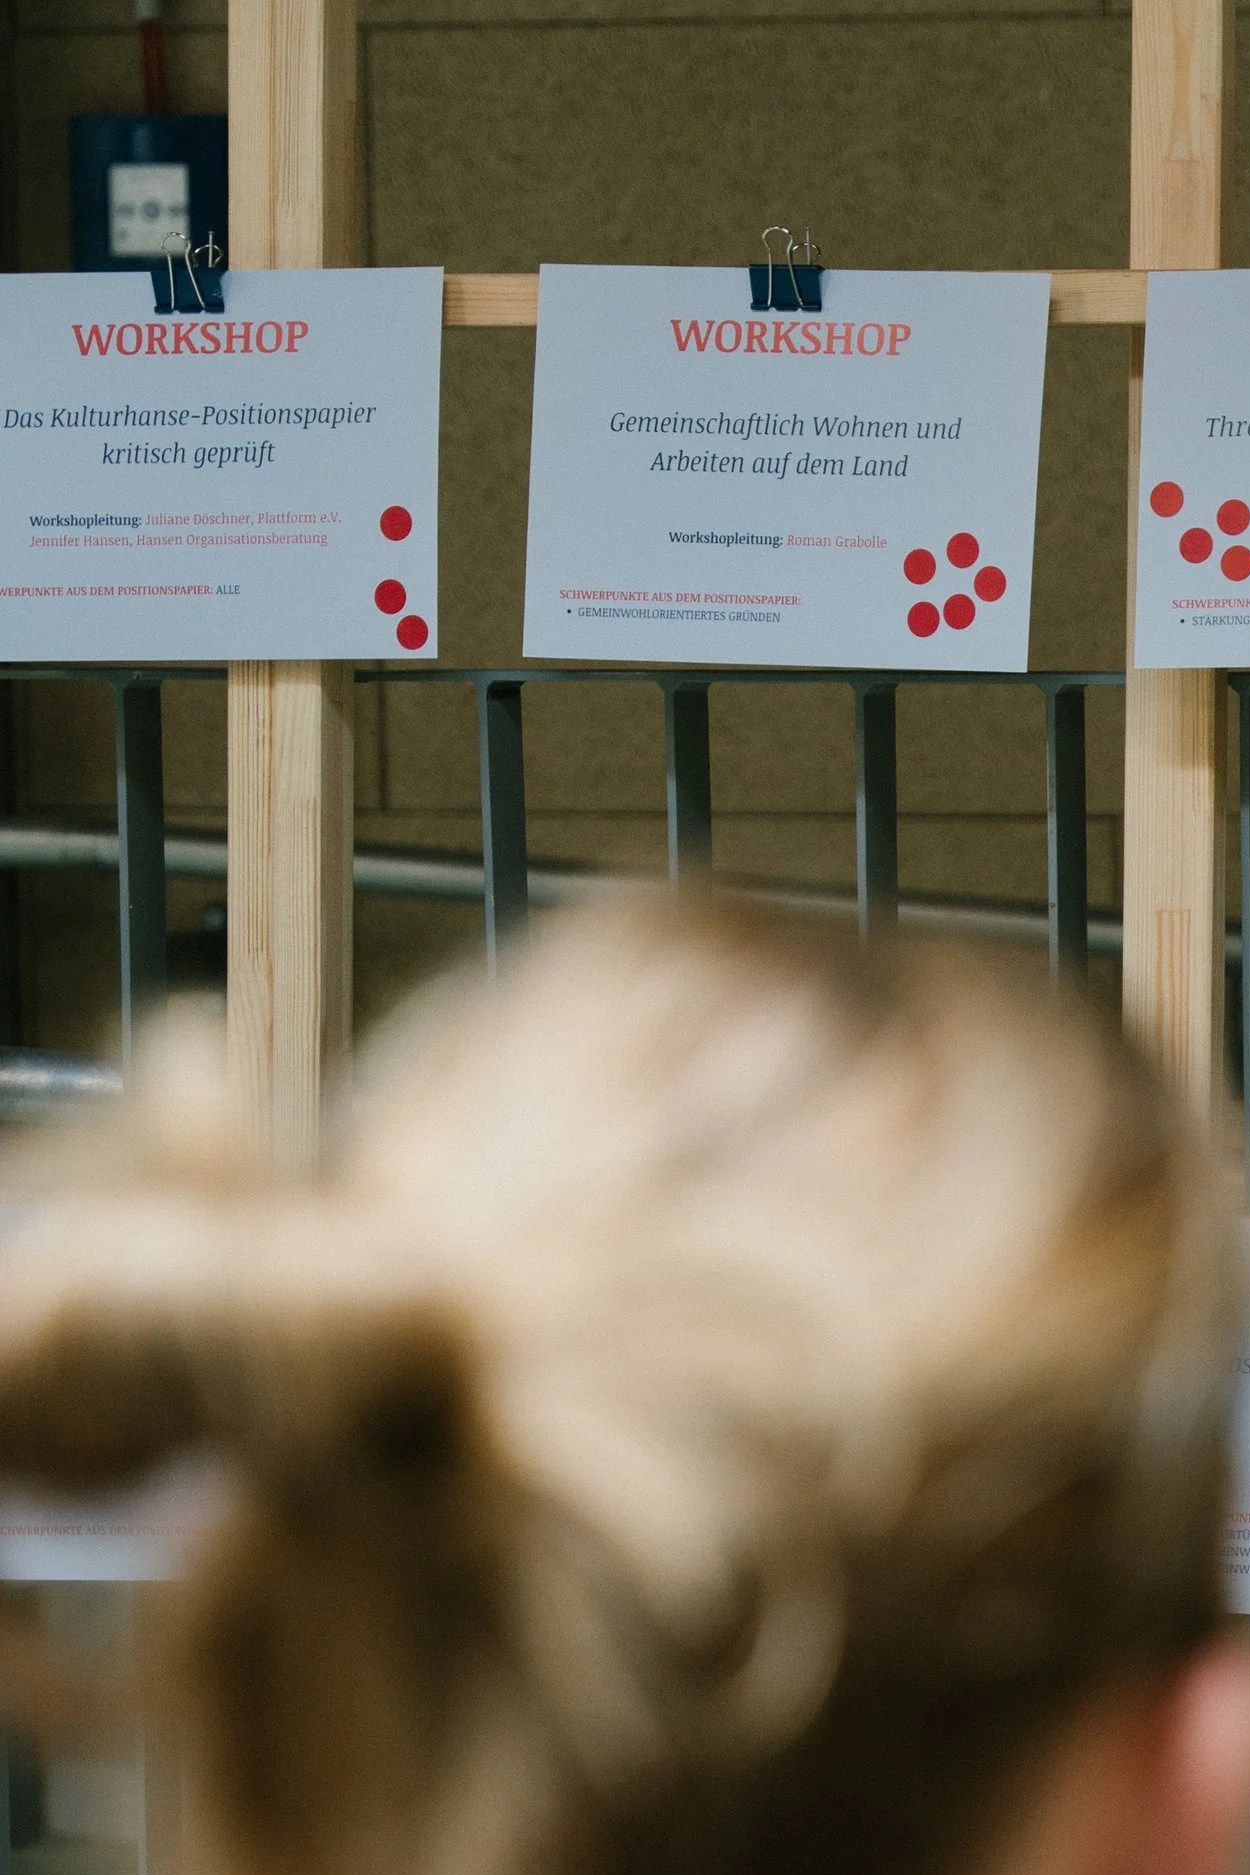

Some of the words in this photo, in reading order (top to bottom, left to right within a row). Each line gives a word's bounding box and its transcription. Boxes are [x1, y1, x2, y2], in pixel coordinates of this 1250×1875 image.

[72, 321, 309, 356] WORKSHOP
[670, 320, 911, 355] WORKSHOP
[4, 409, 44, 428] Das
[50, 402, 376, 430] Kulturhanse-Positionspapier
[610, 412, 804, 441] Gemeinschaftlich
[812, 415, 907, 438] Wohnen
[916, 417, 962, 439] und
[102, 442, 186, 464] kritisch
[193, 440, 276, 469] geprüft
[650, 449, 744, 473] Arbeiten
[752, 452, 792, 480] auf
[796, 452, 844, 475] dem
[852, 455, 908, 477] Land
[30, 513, 141, 529] Workshopleitung:
[145, 513, 189, 526] Juliane
[194, 512, 254, 526] Döschner,
[258, 511, 316, 524] Plattform
[320, 513, 341, 523] e.V.
[30, 534, 79, 548] Jennifer
[83, 535, 132, 547] Hansen,
[136, 534, 182, 546] Hansen
[186, 532, 327, 545] Organisationsberatung
[669, 531, 783, 549] Workshopleitung:
[787, 534, 832, 547] Roman
[835, 534, 887, 548] Grabolle
[66, 586, 87, 596] AUS
[90, 586, 114, 596] DEM
[117, 585, 213, 596] POSITIONSPAPIER:
[216, 584, 240, 595] ALLE
[559, 590, 649, 601] SCHWERPUNKTE
[652, 592, 673, 602] AUS
[675, 592, 700, 603] DEM
[704, 593, 801, 605] POSITIONSPAPIER:
[578, 607, 726, 621] GEMEINWOHLORIENTIERTES
[729, 609, 781, 623] GRÜNDEN
[1192, 614, 1250, 626] STÄRKUNG
